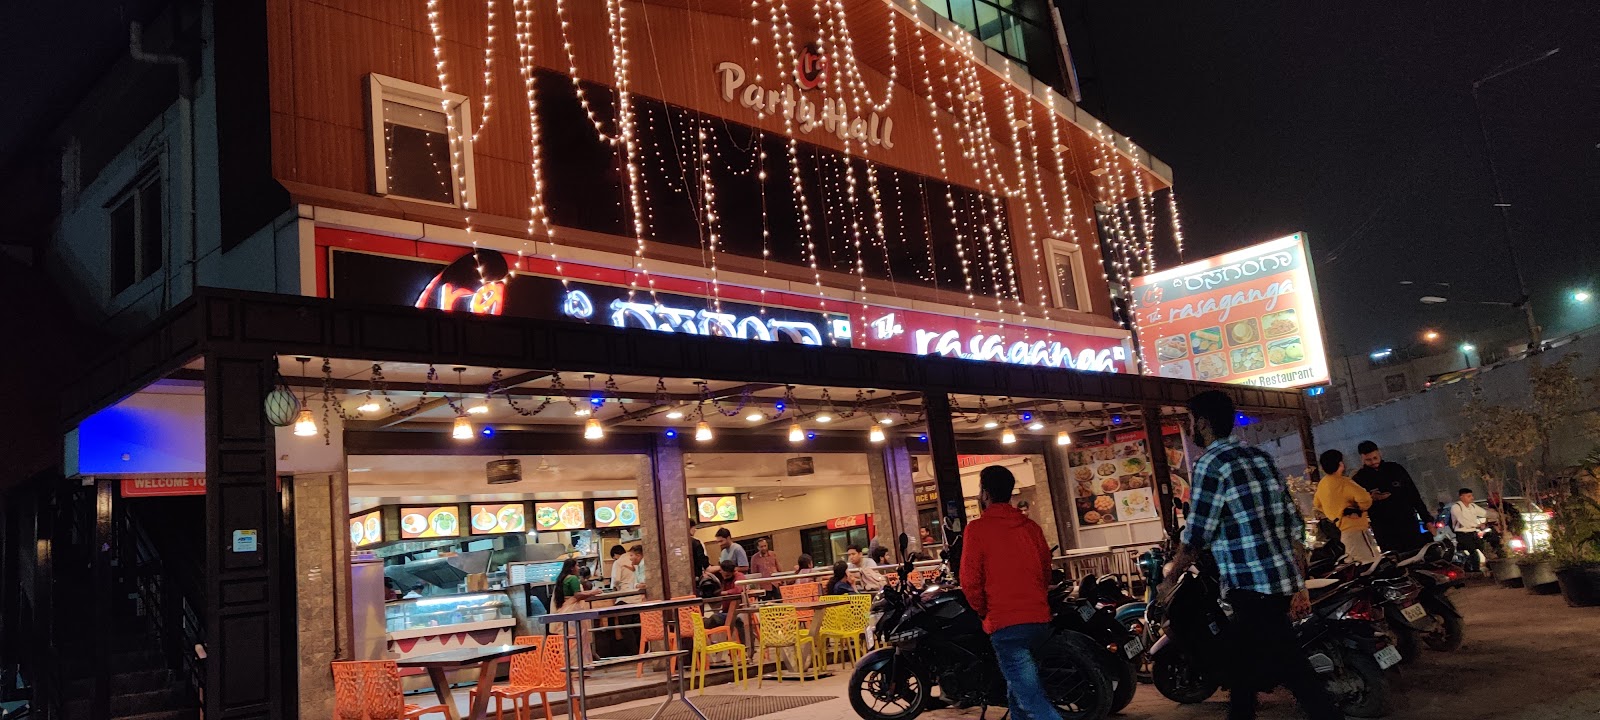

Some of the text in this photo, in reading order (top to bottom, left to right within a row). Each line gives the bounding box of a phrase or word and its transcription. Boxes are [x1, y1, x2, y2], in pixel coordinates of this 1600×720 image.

[715, 60, 894, 150] Party Hall
[1169, 278, 1295, 323] rasaganga
[870, 312, 904, 339] The
[1259, 366, 1314, 387] Restaurant
[135, 478, 189, 488] WELCOME
